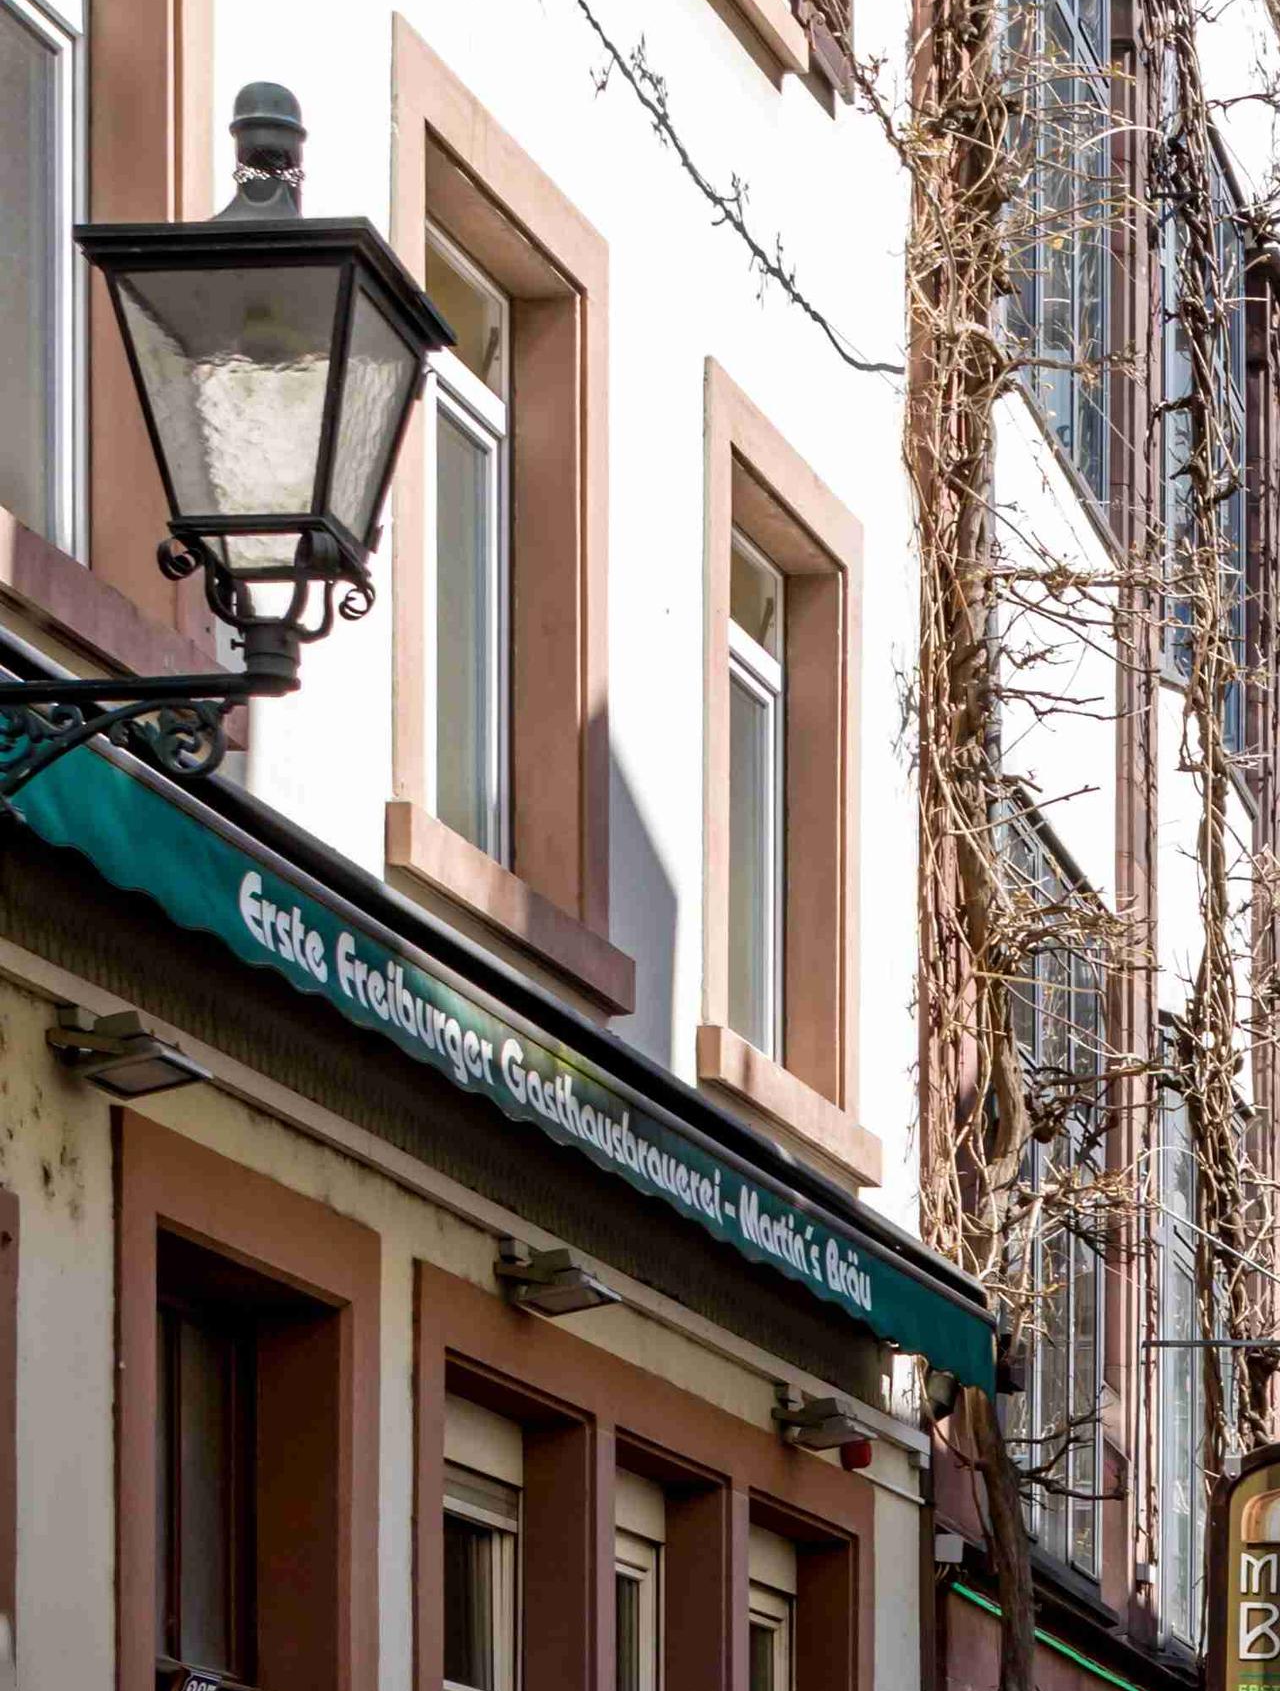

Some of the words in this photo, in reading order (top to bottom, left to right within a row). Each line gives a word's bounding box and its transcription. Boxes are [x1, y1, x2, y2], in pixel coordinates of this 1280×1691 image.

[239, 871, 328, 983] Erste
[335, 931, 493, 1085] Freiburger
[501, 1038, 724, 1226] Gasthausbrauerei
[826, 1238, 872, 1311] Bräu
